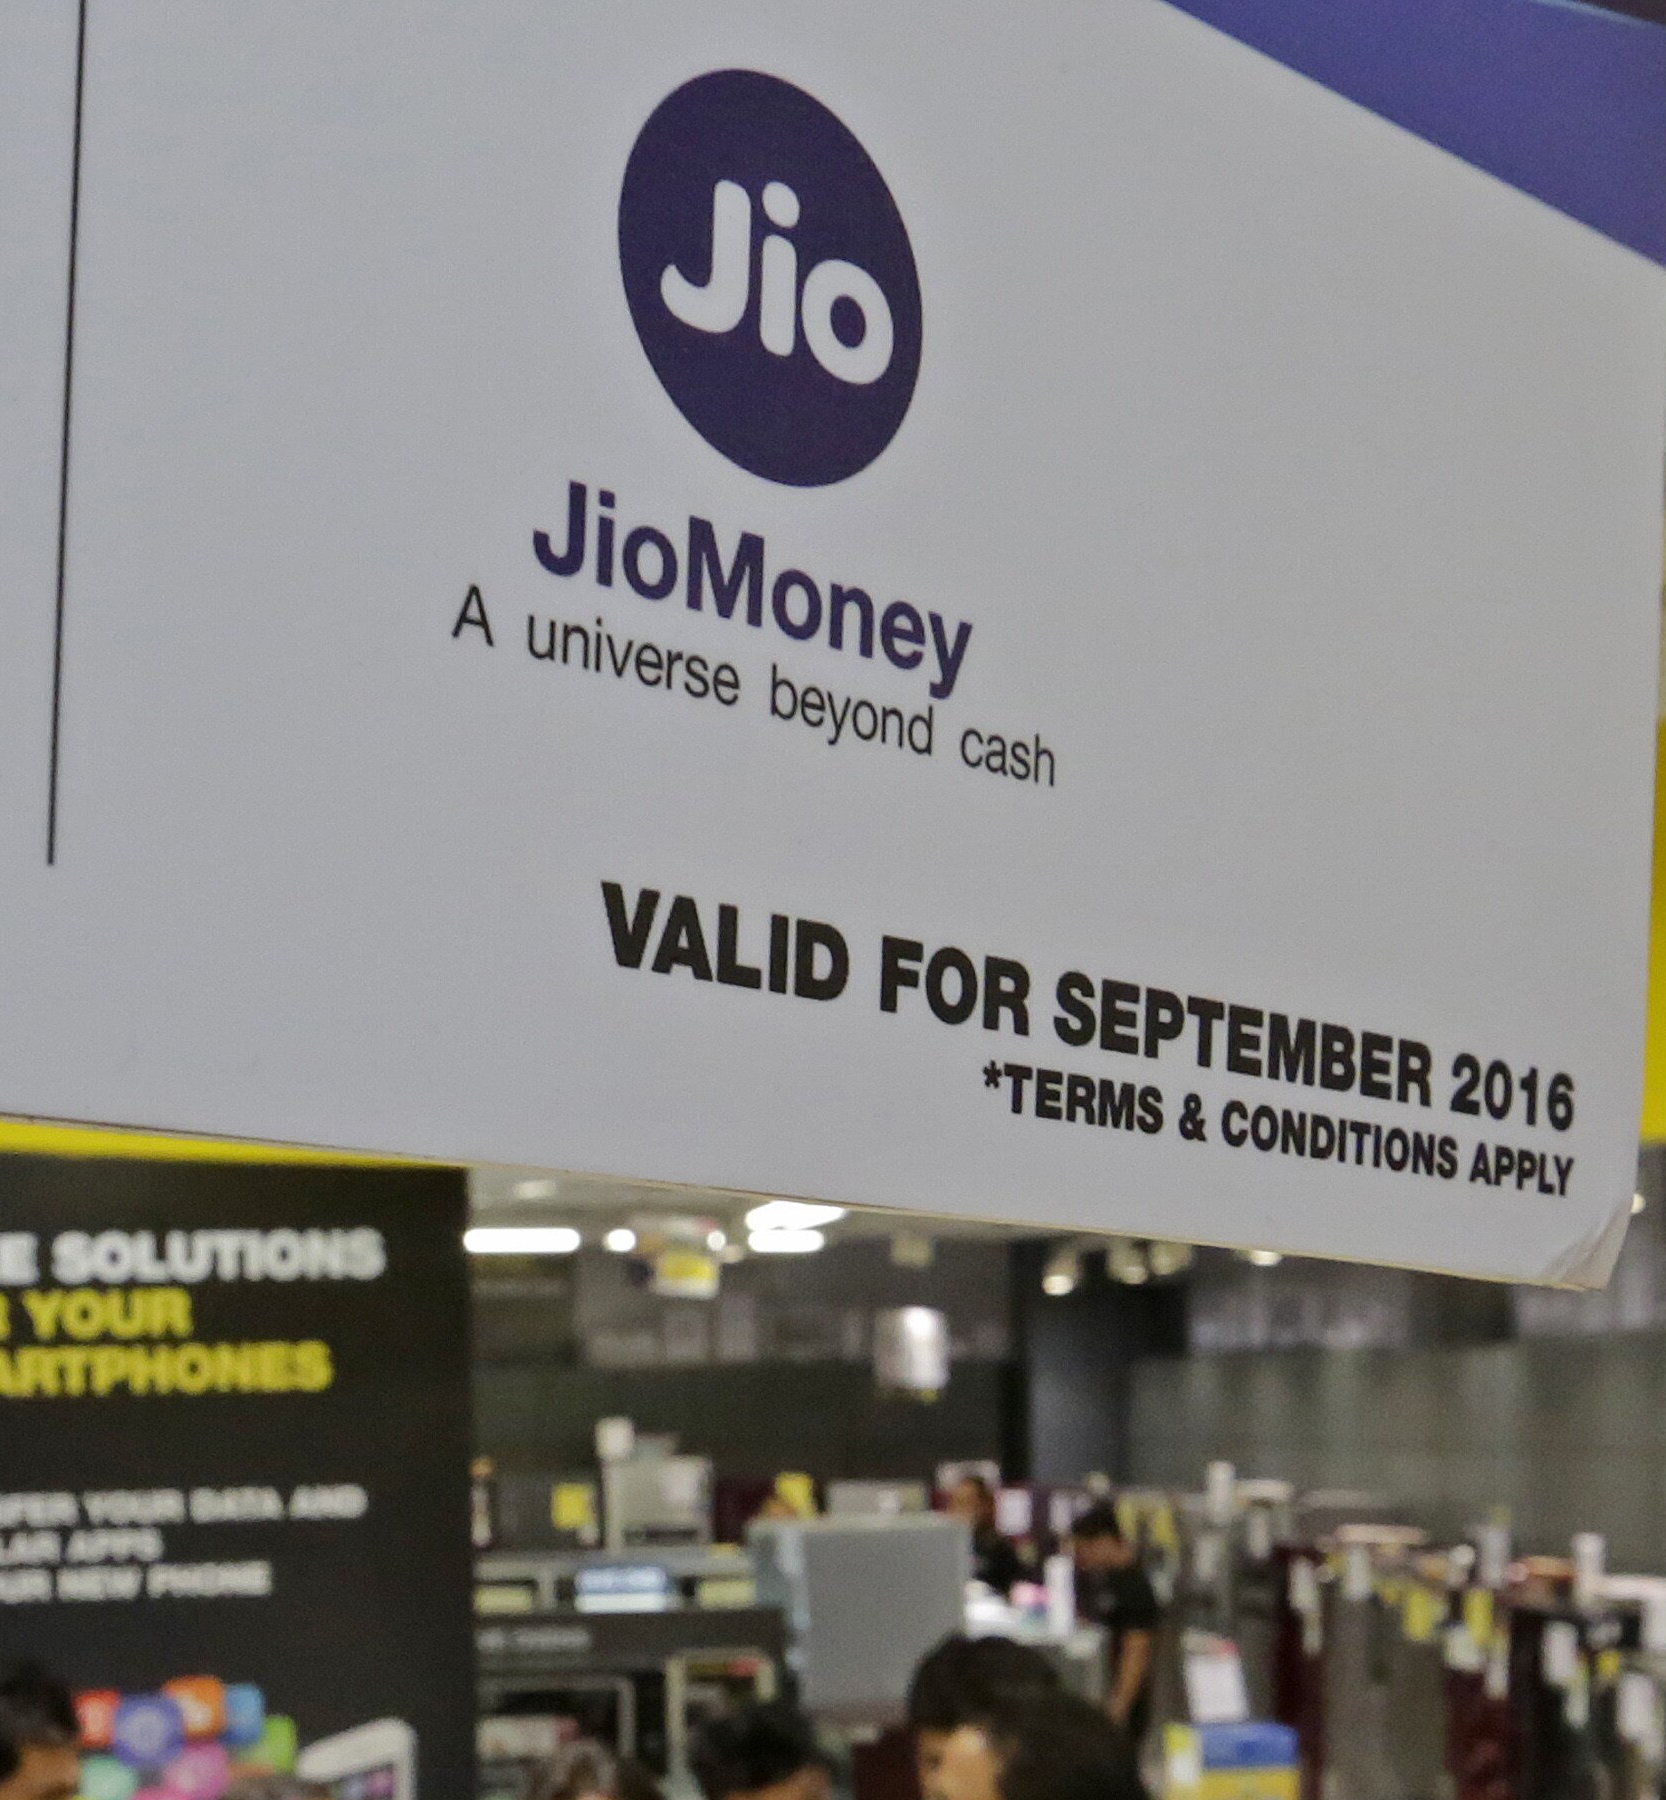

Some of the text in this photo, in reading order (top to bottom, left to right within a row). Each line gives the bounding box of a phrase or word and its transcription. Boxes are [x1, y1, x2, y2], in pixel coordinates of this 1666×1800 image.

[660, 180, 895, 386] Jio
[532, 480, 973, 700] JioMoney
[451, 584, 1056, 788] A universe beyond cash
[600, 880, 1575, 1133] VALID FOR SEPTEMBER 2016
[1178, 1092, 1208, 1143] &
[1220, 1100, 1458, 1180] CONDITIONS
[1468, 1142, 1575, 1198] APPLY
[52, 1227, 386, 1284] SOLUTIONS
[23, 1287, 192, 1339] YOUR
[66, 1527, 164, 1563] APPS
[83, 1487, 184, 1526] YOUR
[190, 1485, 282, 1523] DATA
[289, 1484, 368, 1520] AND
[56, 1563, 142, 1600] NEW
[146, 1559, 273, 1598] PHONE
